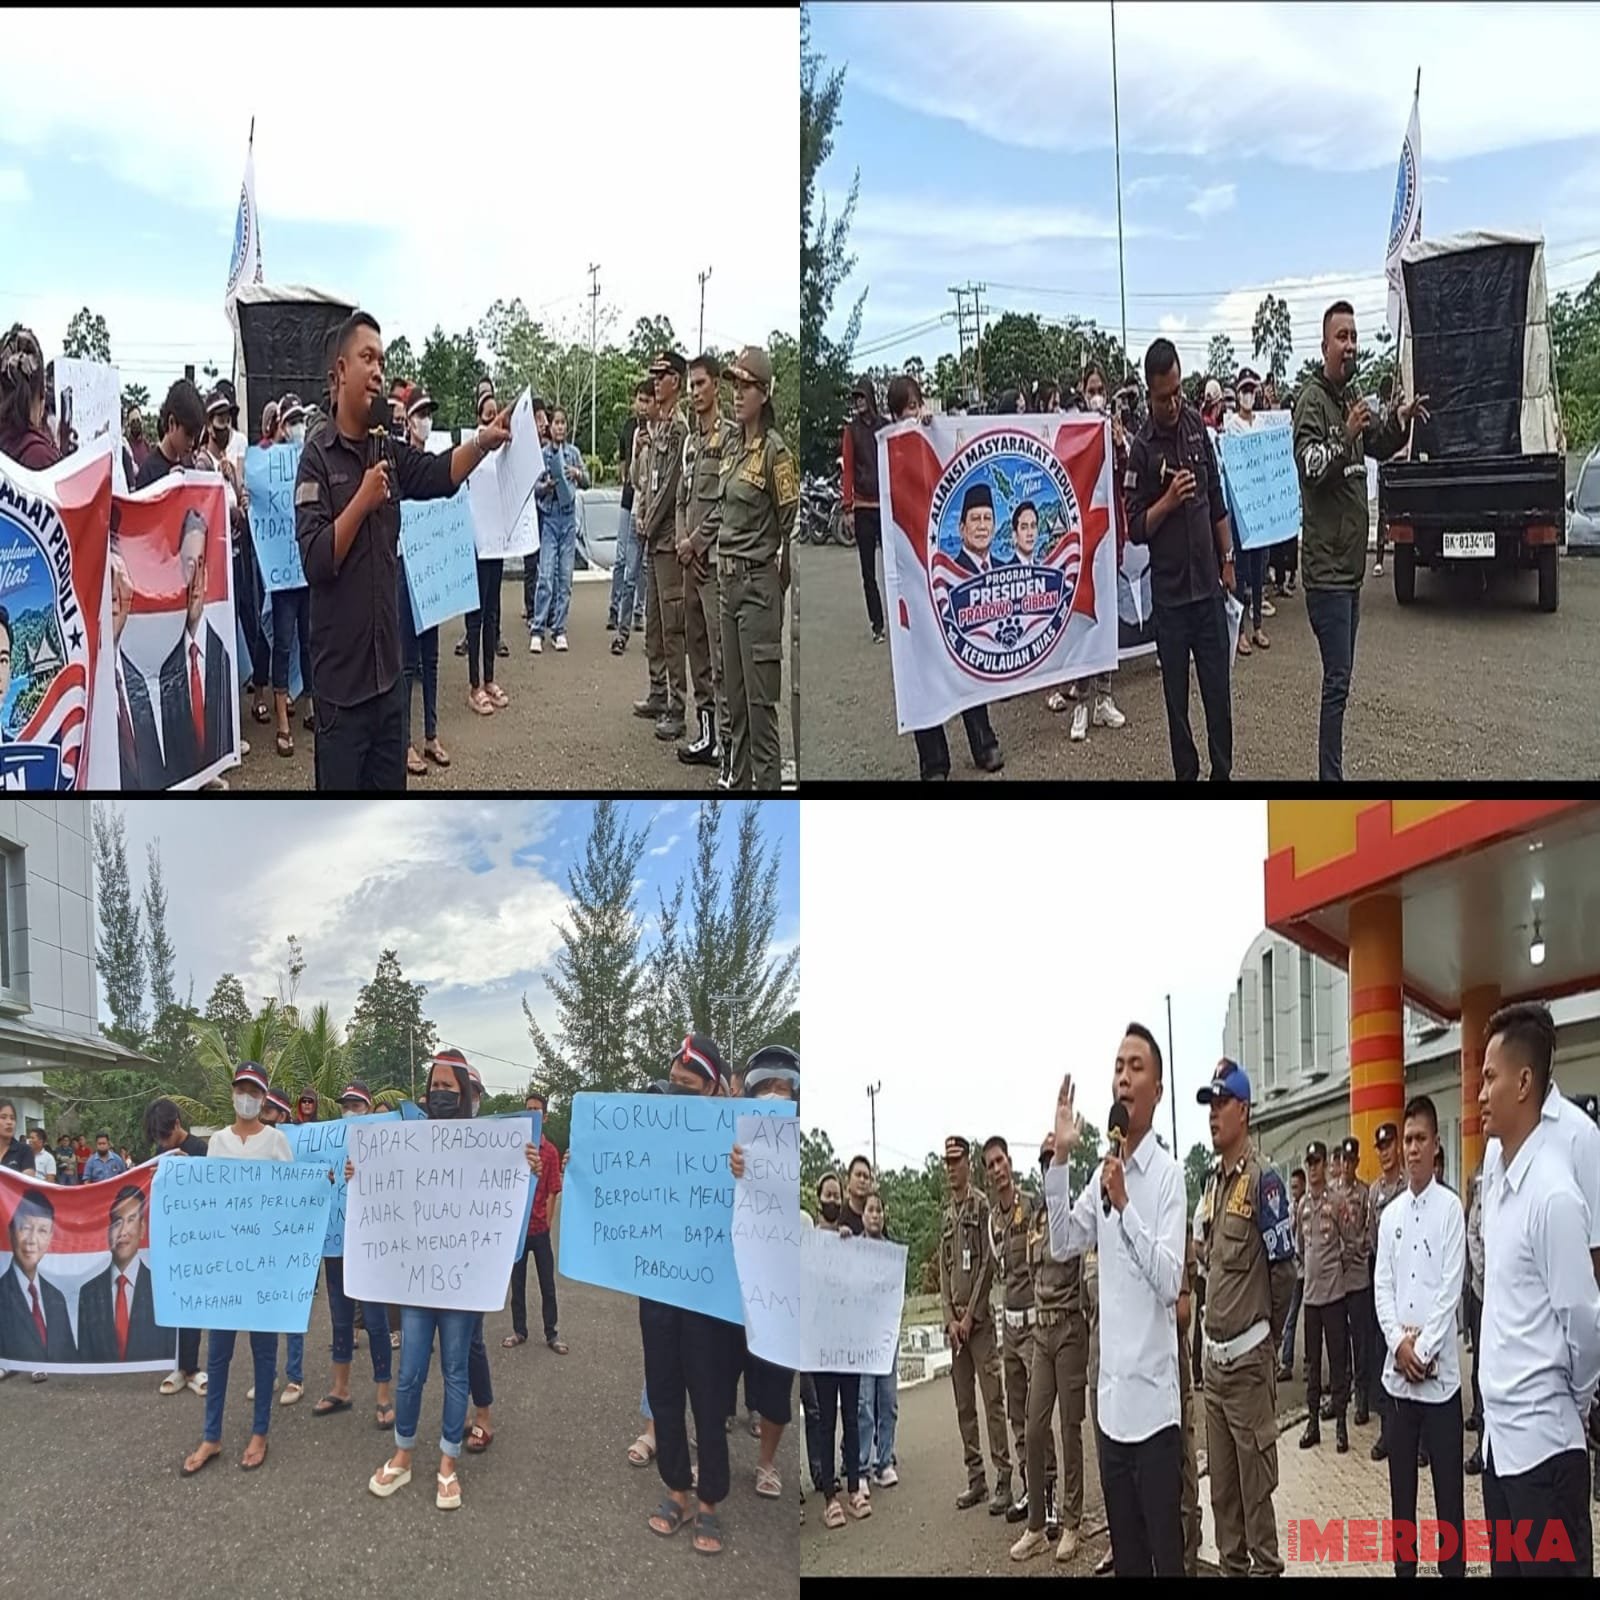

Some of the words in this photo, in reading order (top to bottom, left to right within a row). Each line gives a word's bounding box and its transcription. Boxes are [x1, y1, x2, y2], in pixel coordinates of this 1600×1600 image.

[930, 459, 966, 525] ALIANSI
[965, 436, 1050, 468] MASYARAKAT
[1049, 458, 1077, 511] PEDULI
[48, 522, 78, 622] PEDULI
[985, 569, 1032, 586] PROGRAM
[969, 578, 1047, 607] PRESIDEN
[959, 600, 1014, 628] PRABOWO
[1021, 590, 1059, 613] GIBRAN
[960, 643, 1031, 672] KEPULAUAN
[1031, 625, 1057, 658] NIAS
[593, 1100, 705, 1132] KORWIL
[297, 1124, 347, 1154] HUKU
[356, 1128, 420, 1164] BAPAK
[431, 1125, 523, 1154] PRABOWO
[163, 1160, 261, 1188] PENERIMA
[271, 1165, 328, 1182] MANFAAT
[592, 1151, 650, 1175] UTARA
[676, 1151, 731, 1175] IKUT
[358, 1169, 405, 1196] LIHAT
[416, 1167, 464, 1191] KAMI
[163, 1195, 217, 1215] GELISAH
[225, 1197, 254, 1211] ATAS
[260, 1194, 324, 1211] PERILAKU
[594, 1185, 680, 1209] BERPOLITIK
[736, 1190, 785, 1216] ADA
[359, 1200, 404, 1229] ANAK
[414, 1199, 461, 1228] PULAU
[469, 1199, 513, 1219] NIAS
[169, 1224, 225, 1248] KORWIL
[231, 1223, 261, 1237] YANG
[272, 1221, 315, 1237] SALAH
[361, 1237, 410, 1260] TIDAK
[416, 1230, 502, 1251] MENDAPAT
[593, 1221, 663, 1246] PROGRAM
[684, 1225, 732, 1248] BAPA
[734, 1223, 799, 1247] ANAK
[169, 1255, 276, 1281] MENGELOLAH
[286, 1252, 319, 1269] MBG
[634, 1255, 714, 1285] PRABOWO
